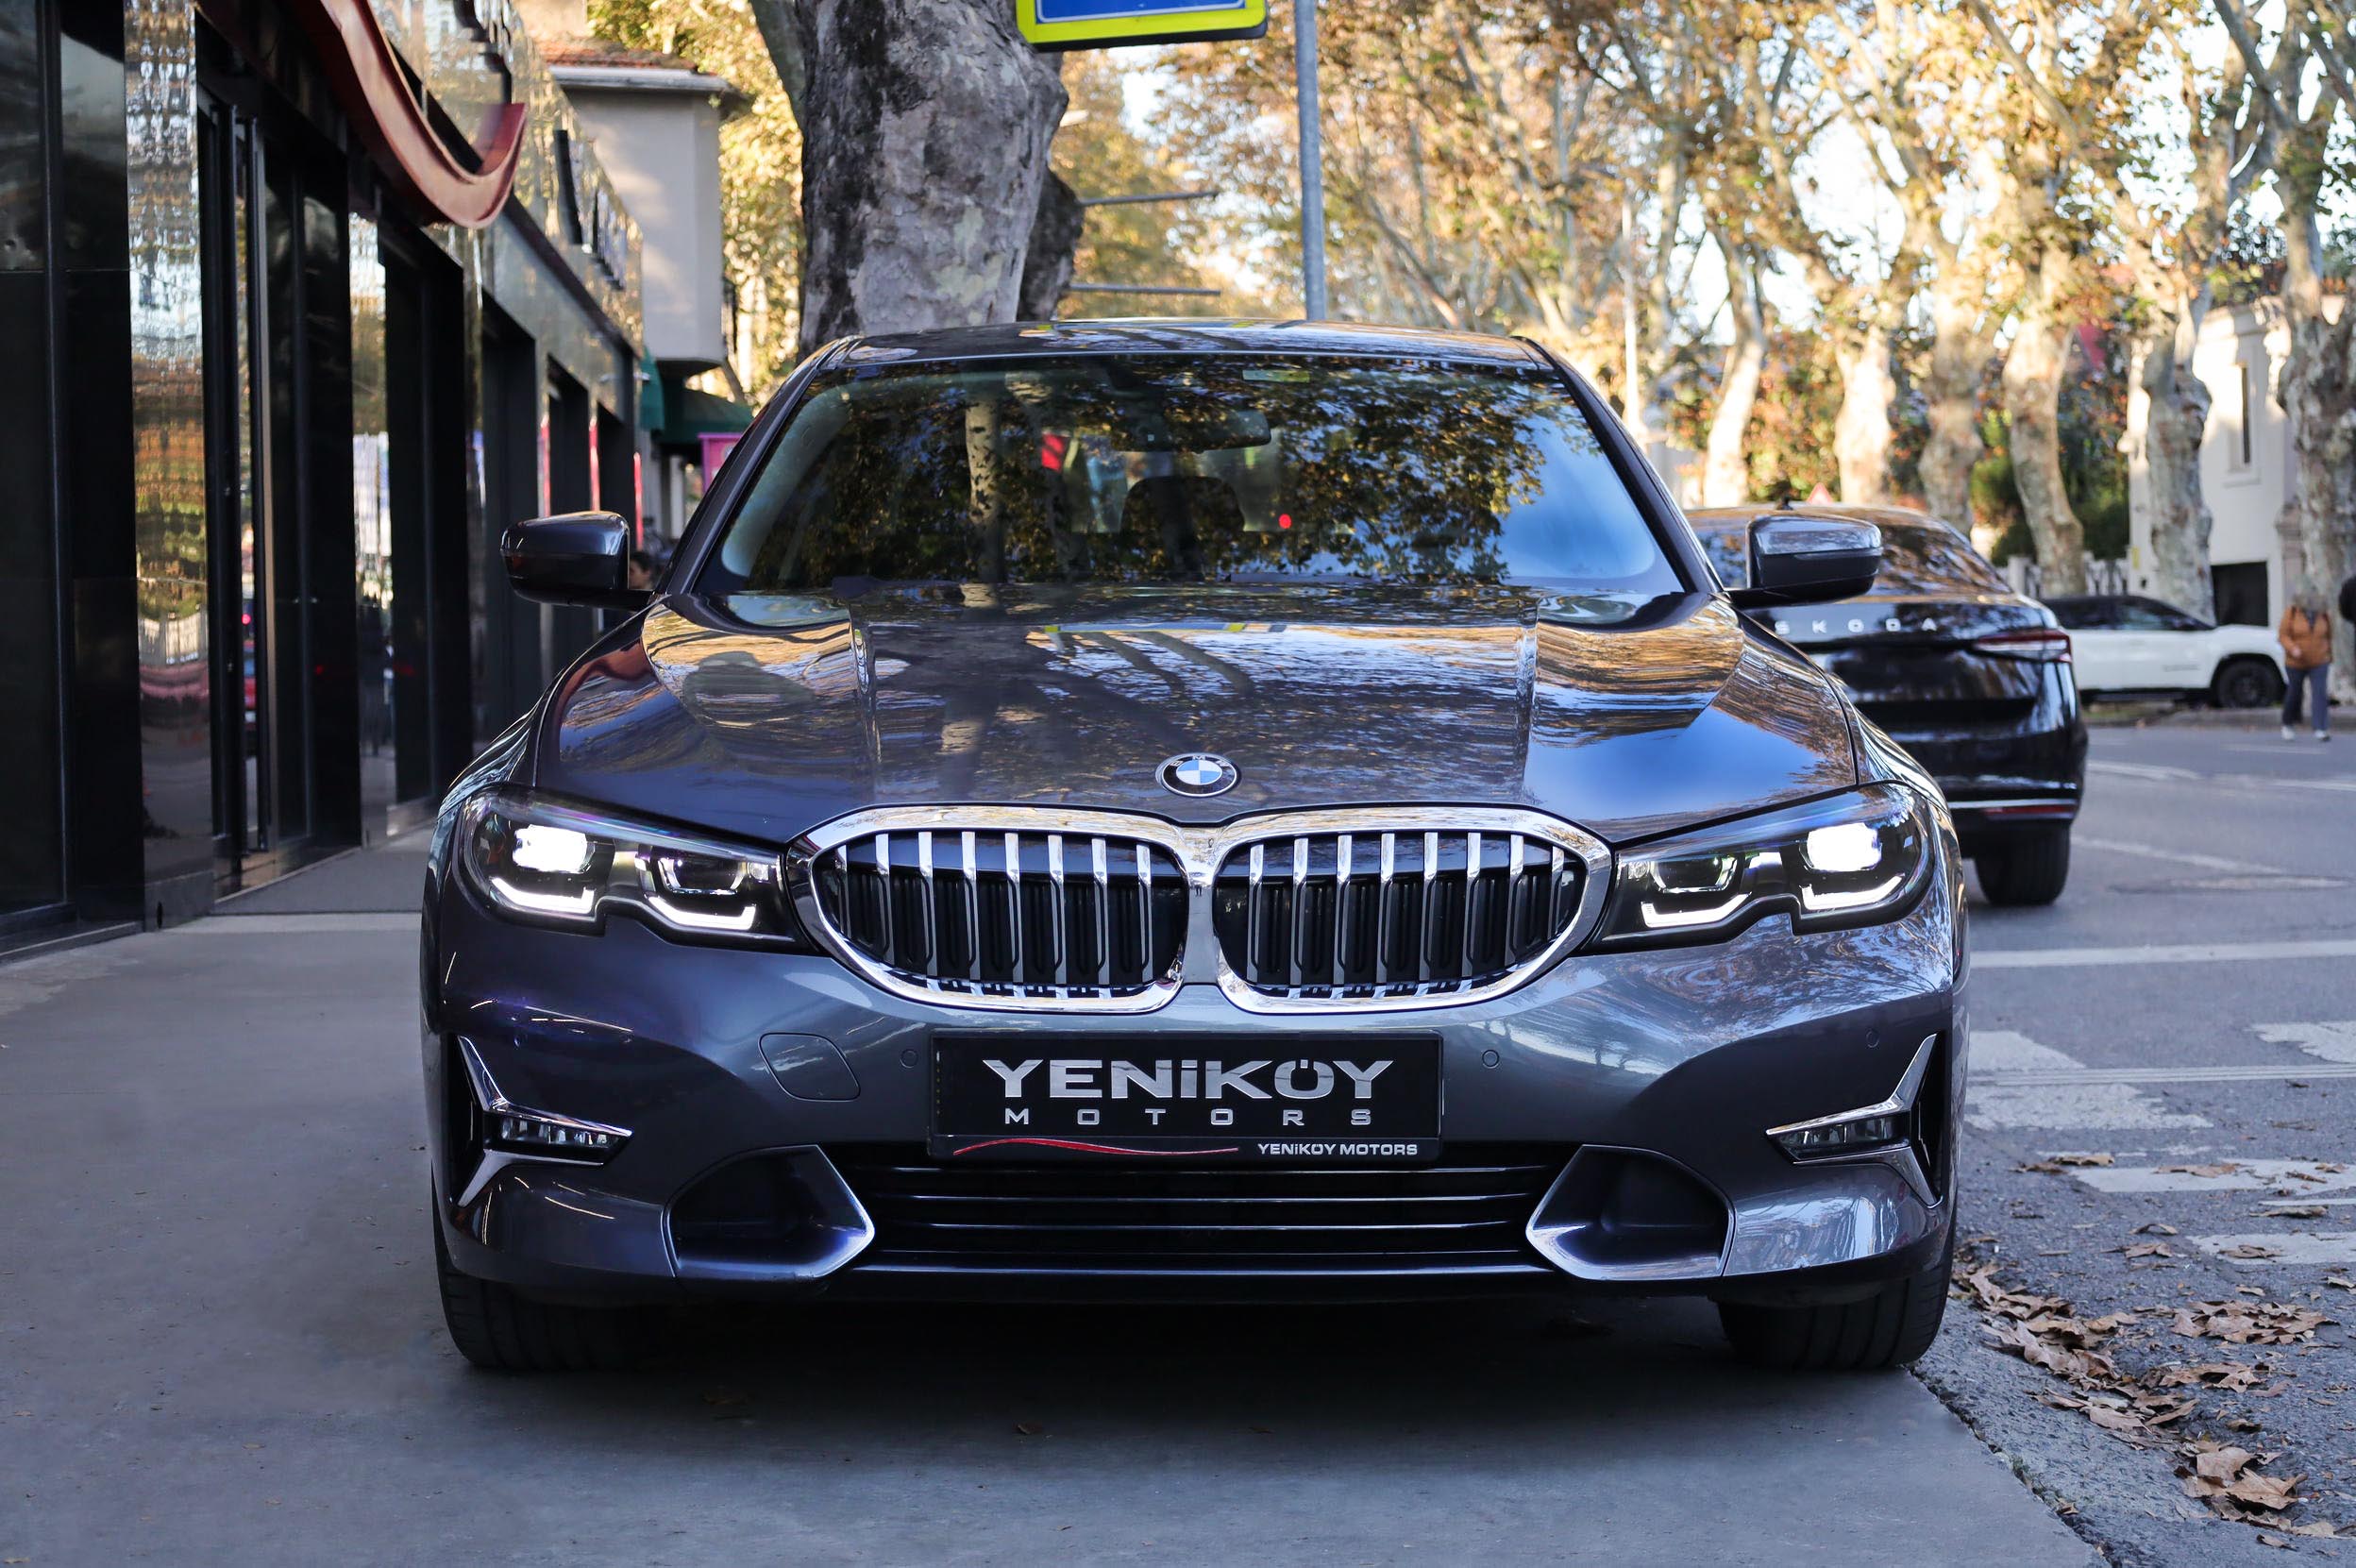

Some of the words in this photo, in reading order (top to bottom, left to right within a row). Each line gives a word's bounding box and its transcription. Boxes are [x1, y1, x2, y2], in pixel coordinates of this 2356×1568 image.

[1775, 617, 1937, 634] SKODA
[1170, 755, 1229, 767] BMW
[1005, 1108, 1372, 1125] MOTORS
[1339, 1143, 1418, 1155] MOTORS
